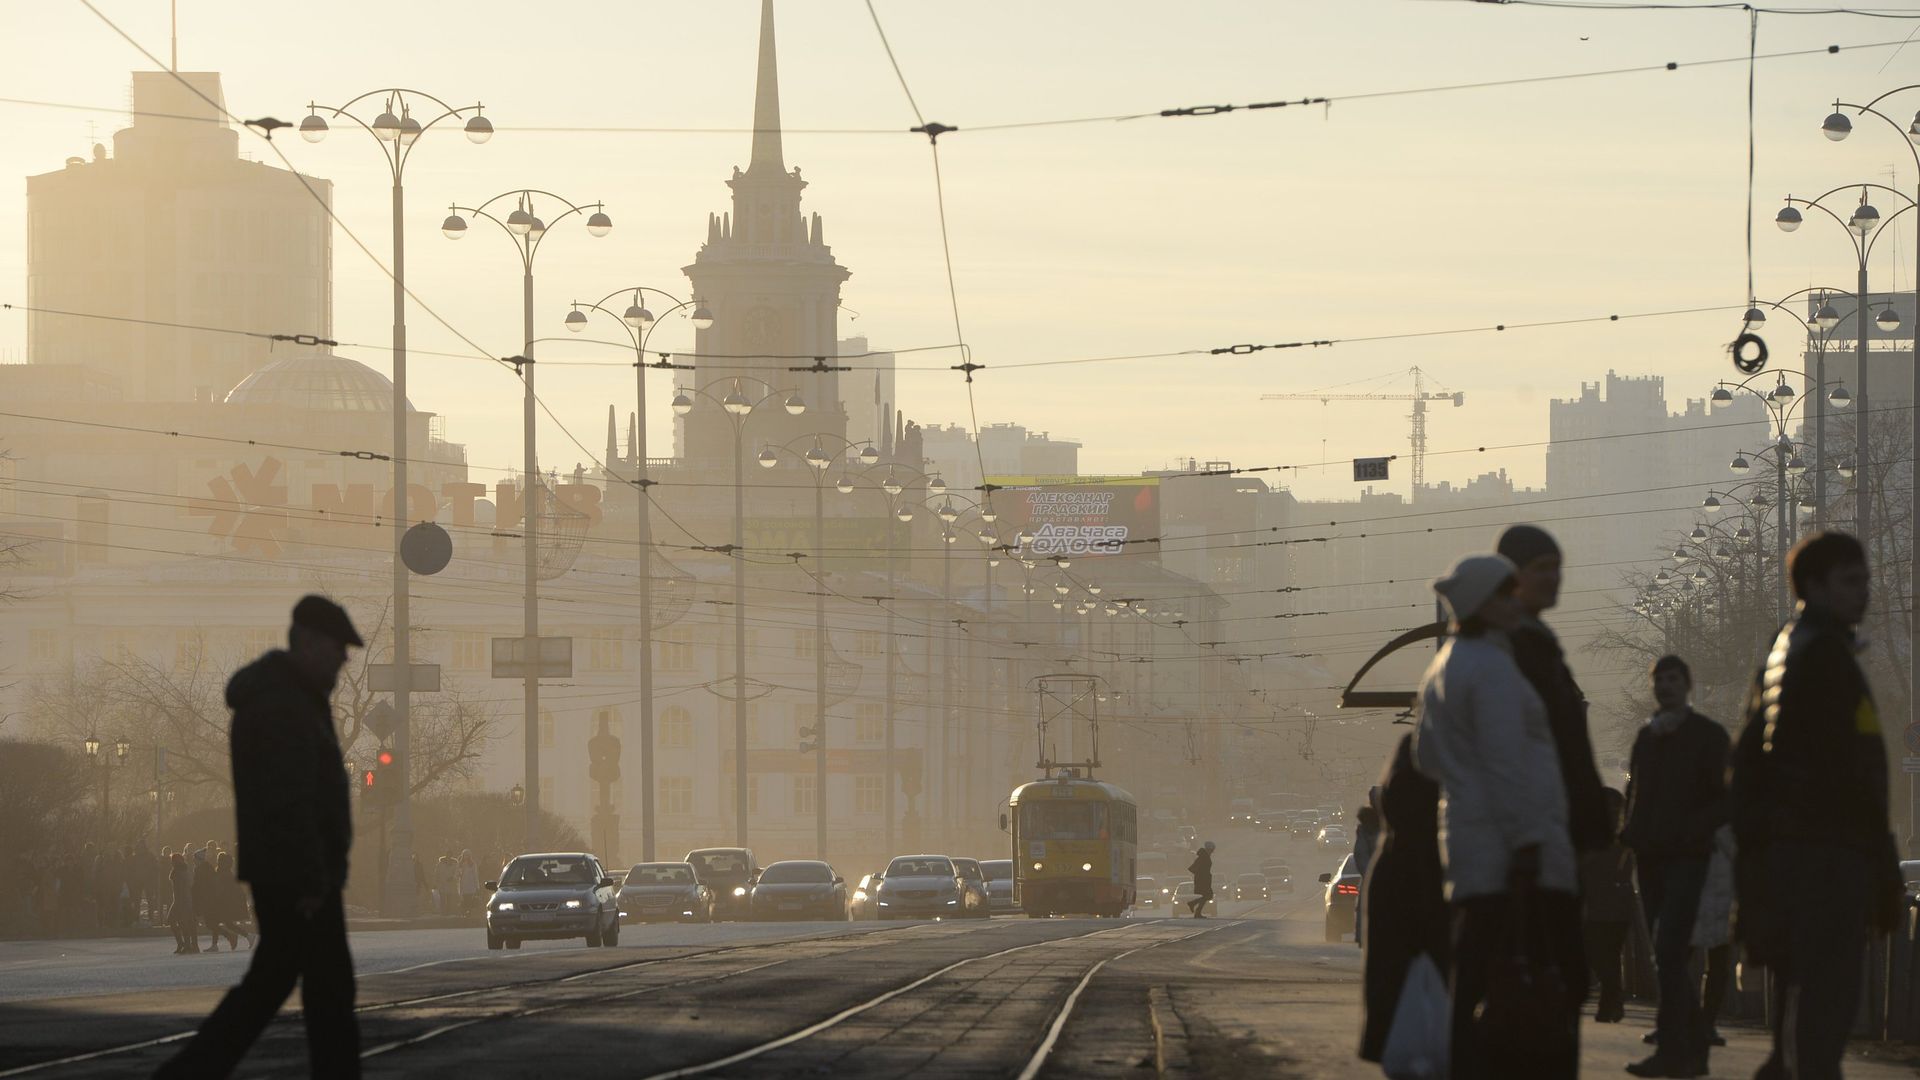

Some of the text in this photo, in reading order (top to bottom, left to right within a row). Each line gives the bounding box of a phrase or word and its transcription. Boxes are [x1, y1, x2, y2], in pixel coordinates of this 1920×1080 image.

[1026, 492, 1113, 504] АЛЕКСАНДР
[1036, 524, 1128, 539] Два часа
